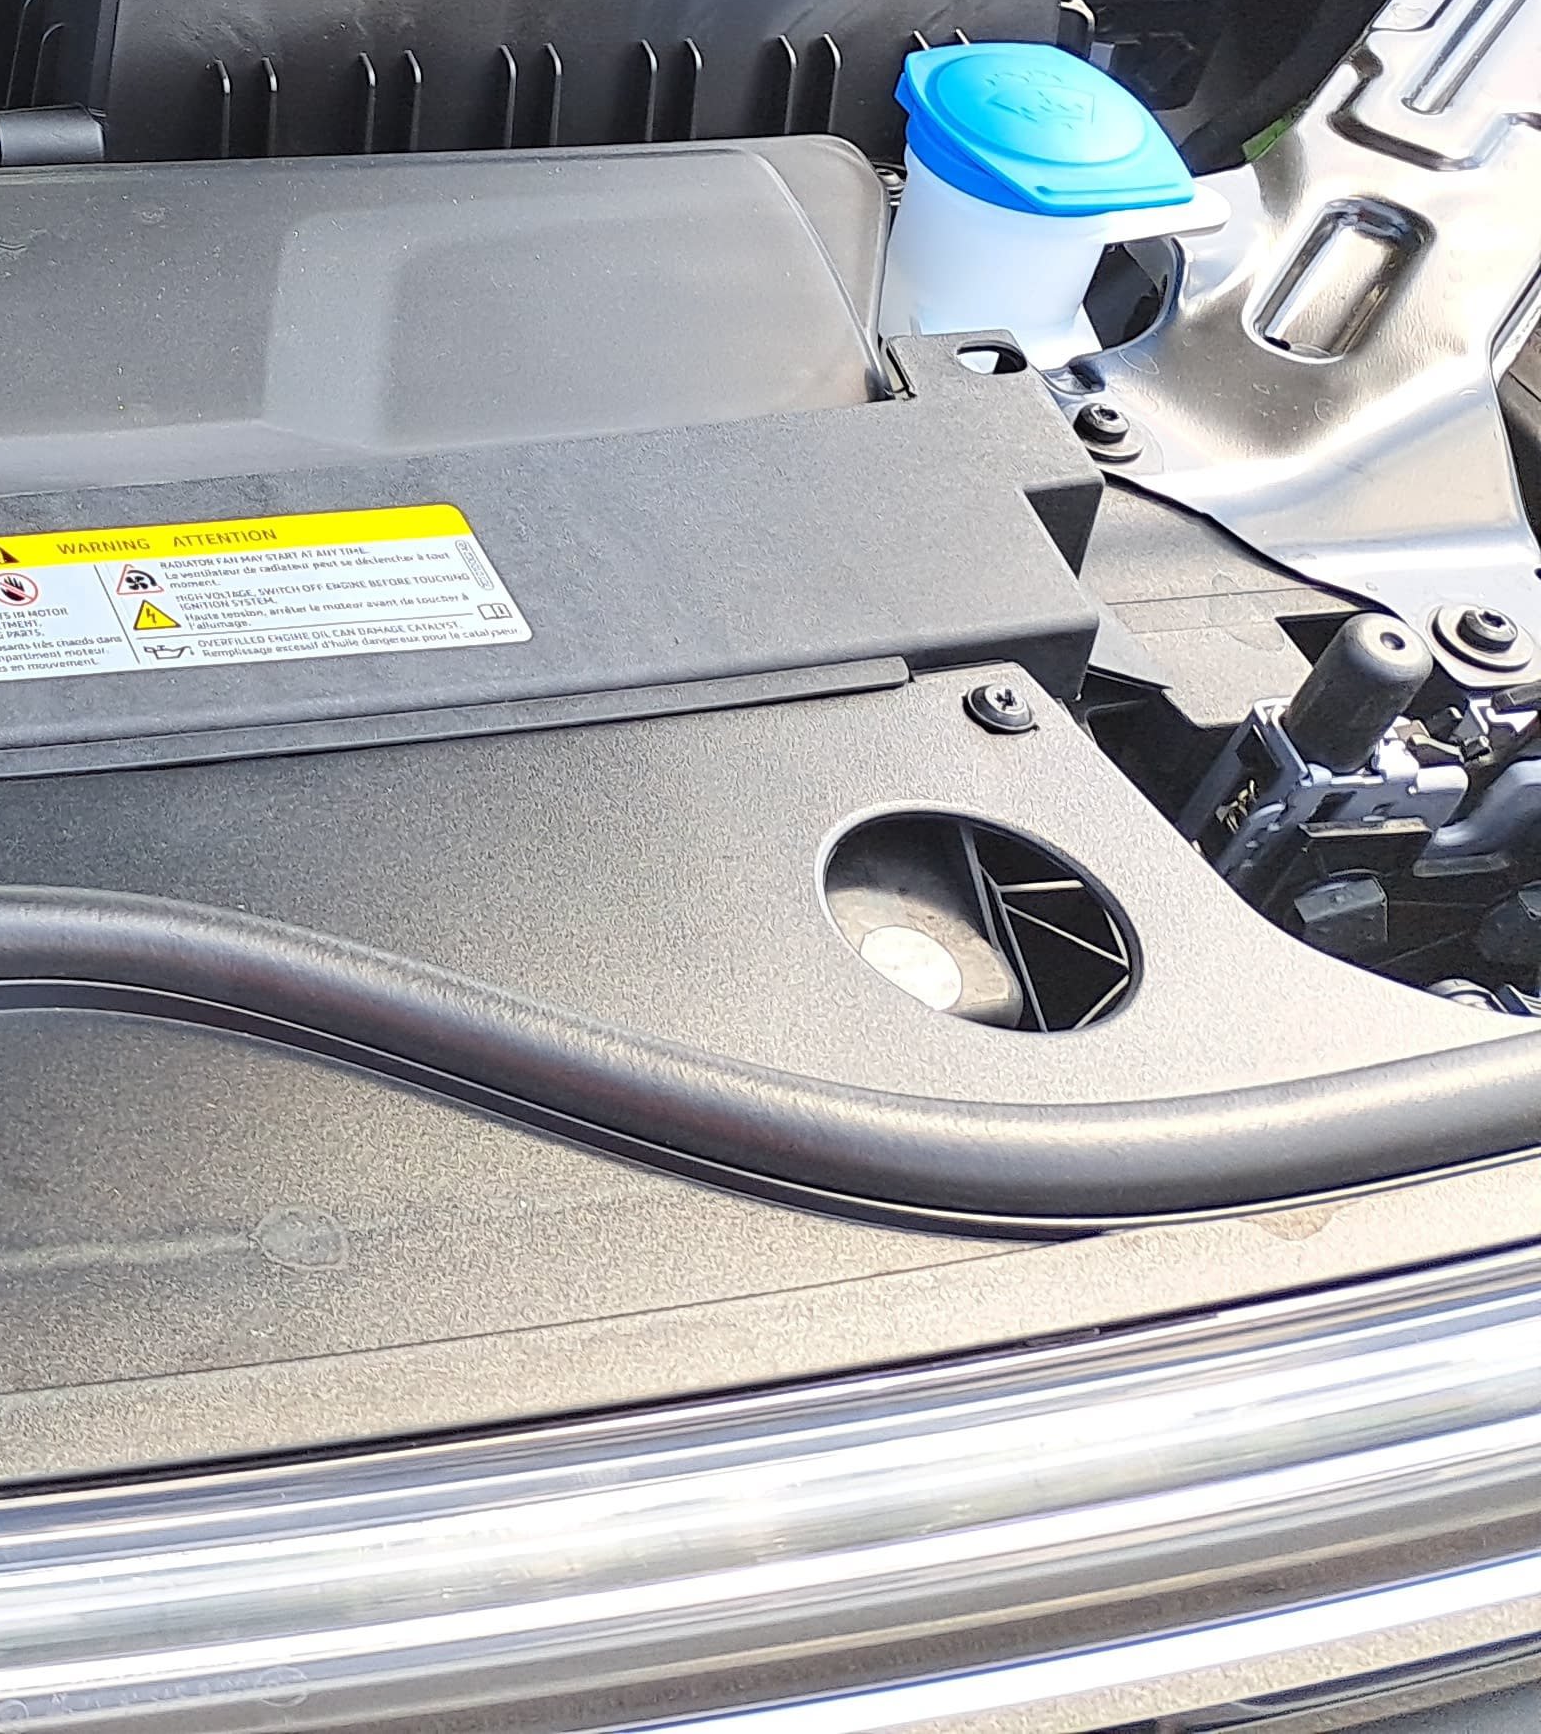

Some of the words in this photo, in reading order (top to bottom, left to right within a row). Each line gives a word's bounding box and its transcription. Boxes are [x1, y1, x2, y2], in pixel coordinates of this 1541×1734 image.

[57, 539, 150, 555] WARNING
[173, 529, 277, 548] ATTENTION
[160, 558, 214, 569] RADIATOR
[216, 557, 239, 566] FAN
[241, 555, 263, 564] MAY
[265, 552, 298, 562] START
[301, 550, 313, 559] AT
[316, 548, 337, 557] ANY
[181, 567, 240, 579] ventilateur
[243, 565, 257, 574] de
[313, 559, 338, 570] peut
[426, 551, 450, 560] tout
[176, 593, 203, 602] HIGH
[258, 586, 300, 596] SWITCH
[302, 584, 322, 593] OFF
[325, 578, 367, 591] ENGINE
[369, 577, 411, 587] BEFORE
[414, 573, 470, 584] TOUCHING
[13, 610, 25, 619] IN
[27, 607, 68, 618] MOTOR
[179, 601, 229, 611] IGNITION
[309, 604, 320, 612] le
[367, 599, 398, 608] avant
[400, 597, 413, 605] de
[96, 634, 122, 643] dans
[198, 635, 265, 647] OVERFILLED
[268, 632, 309, 643] ENGINE
[312, 630, 330, 639] OIL
[332, 628, 356, 638] CAN
[358, 625, 404, 635] DAMAGE
[202, 646, 273, 657] Remplissage
[275, 642, 319, 652] excessif
[362, 636, 418, 647] dangereux
[422, 634, 447, 644] pour
[448, 632, 460, 640] le
